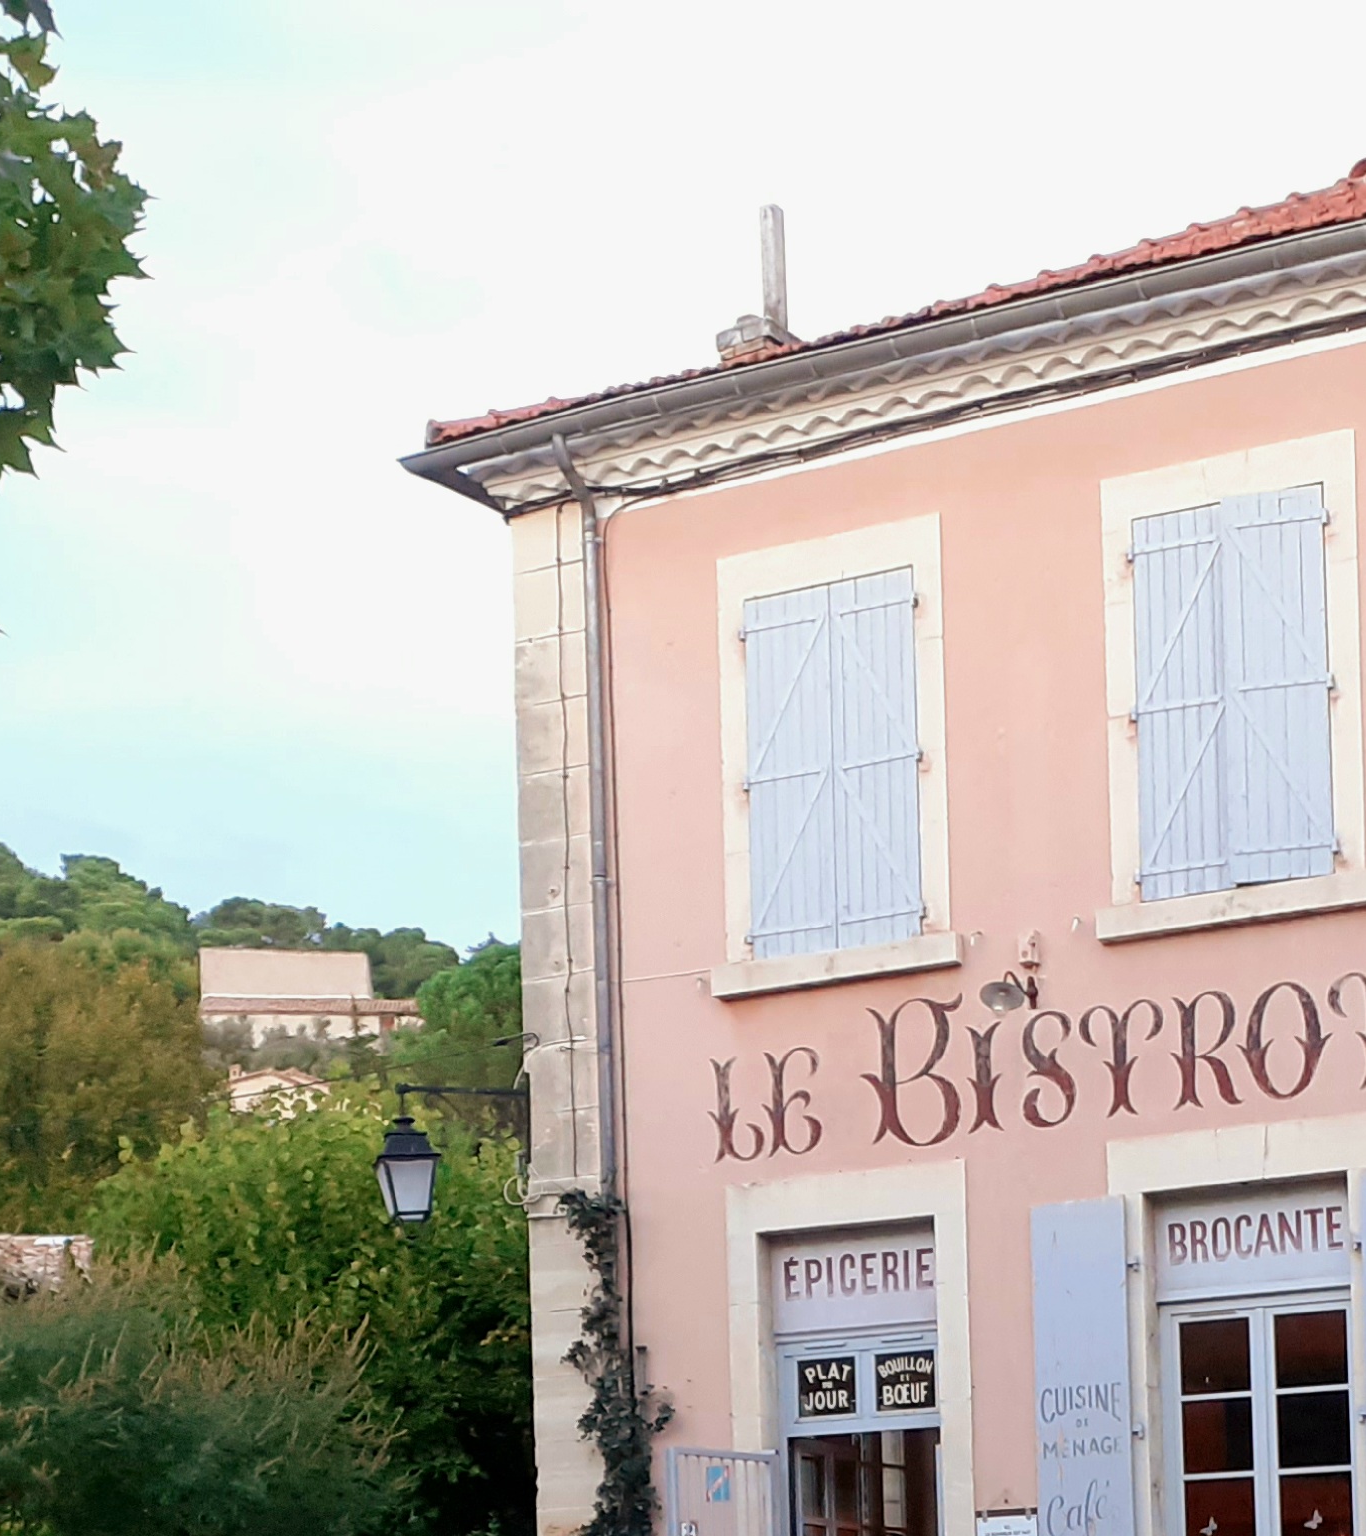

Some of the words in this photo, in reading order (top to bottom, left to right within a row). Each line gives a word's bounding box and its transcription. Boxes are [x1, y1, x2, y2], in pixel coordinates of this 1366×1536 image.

[707, 1046, 822, 1164] LE
[1168, 1206, 1344, 1266] BROCANTE
[783, 1247, 934, 1302] ÉPICERIE
[805, 1362, 852, 1384] PLAT
[877, 1356, 933, 1378] BOUILLON
[804, 1390, 849, 1411] JOUR
[1040, 1382, 1121, 1424] CUISINE
